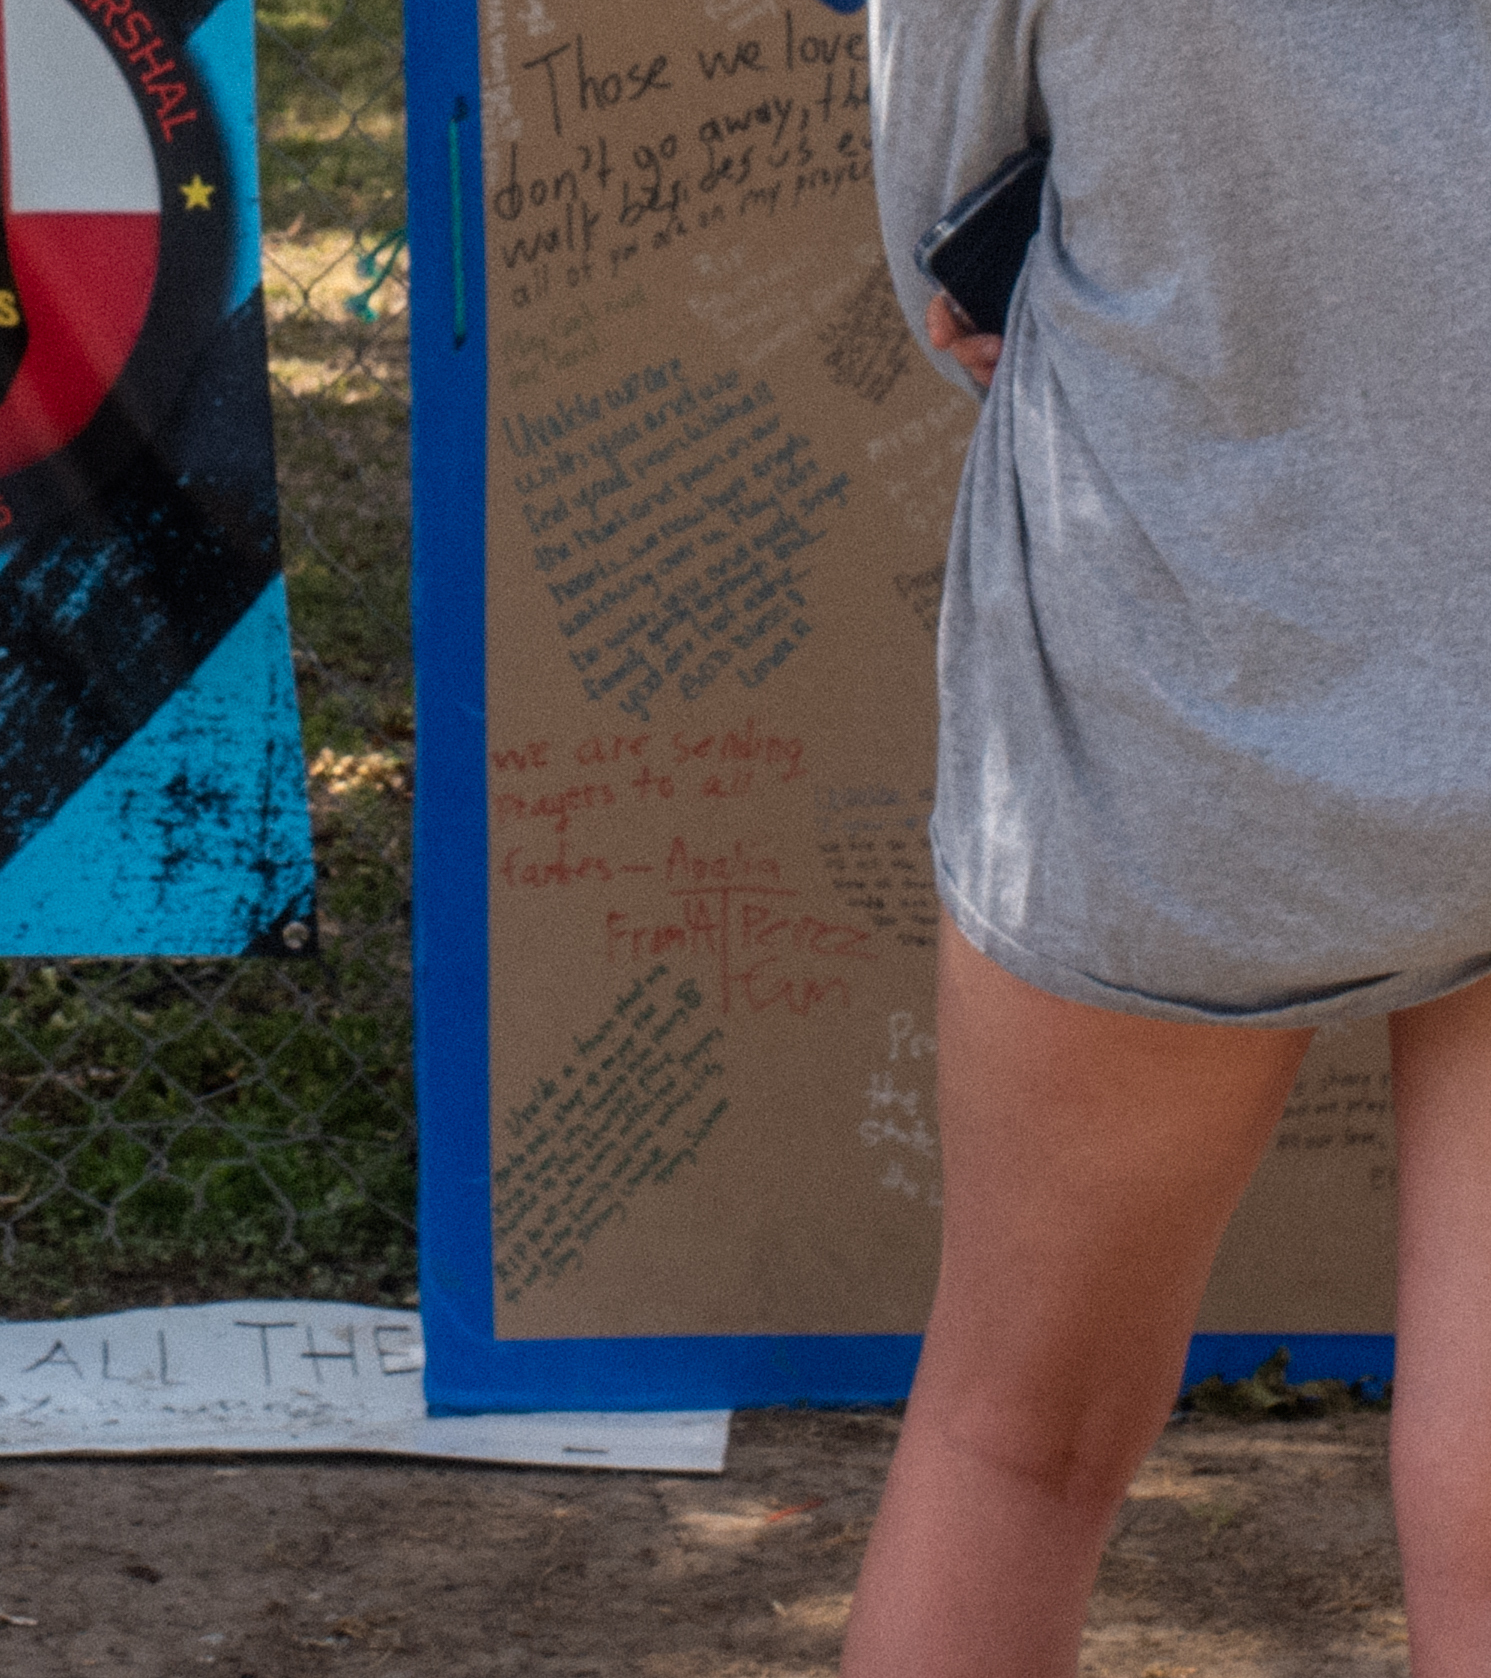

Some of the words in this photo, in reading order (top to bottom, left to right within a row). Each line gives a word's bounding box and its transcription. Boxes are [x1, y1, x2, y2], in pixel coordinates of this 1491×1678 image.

[523, 36, 671, 134] Those
[697, 40, 764, 80] we
[784, 8, 867, 70] love
[493, 141, 613, 221] don't
[632, 133, 679, 189] go
[698, 98, 810, 159] away,
[502, 201, 601, 268] walk
[511, 263, 550, 309] all
[565, 254, 593, 289] of
[575, 733, 650, 767] are
[632, 766, 674, 799] to
[701, 771, 754, 798] all
[24, 1329, 185, 1385] ALL
[233, 1321, 422, 1386] THE
